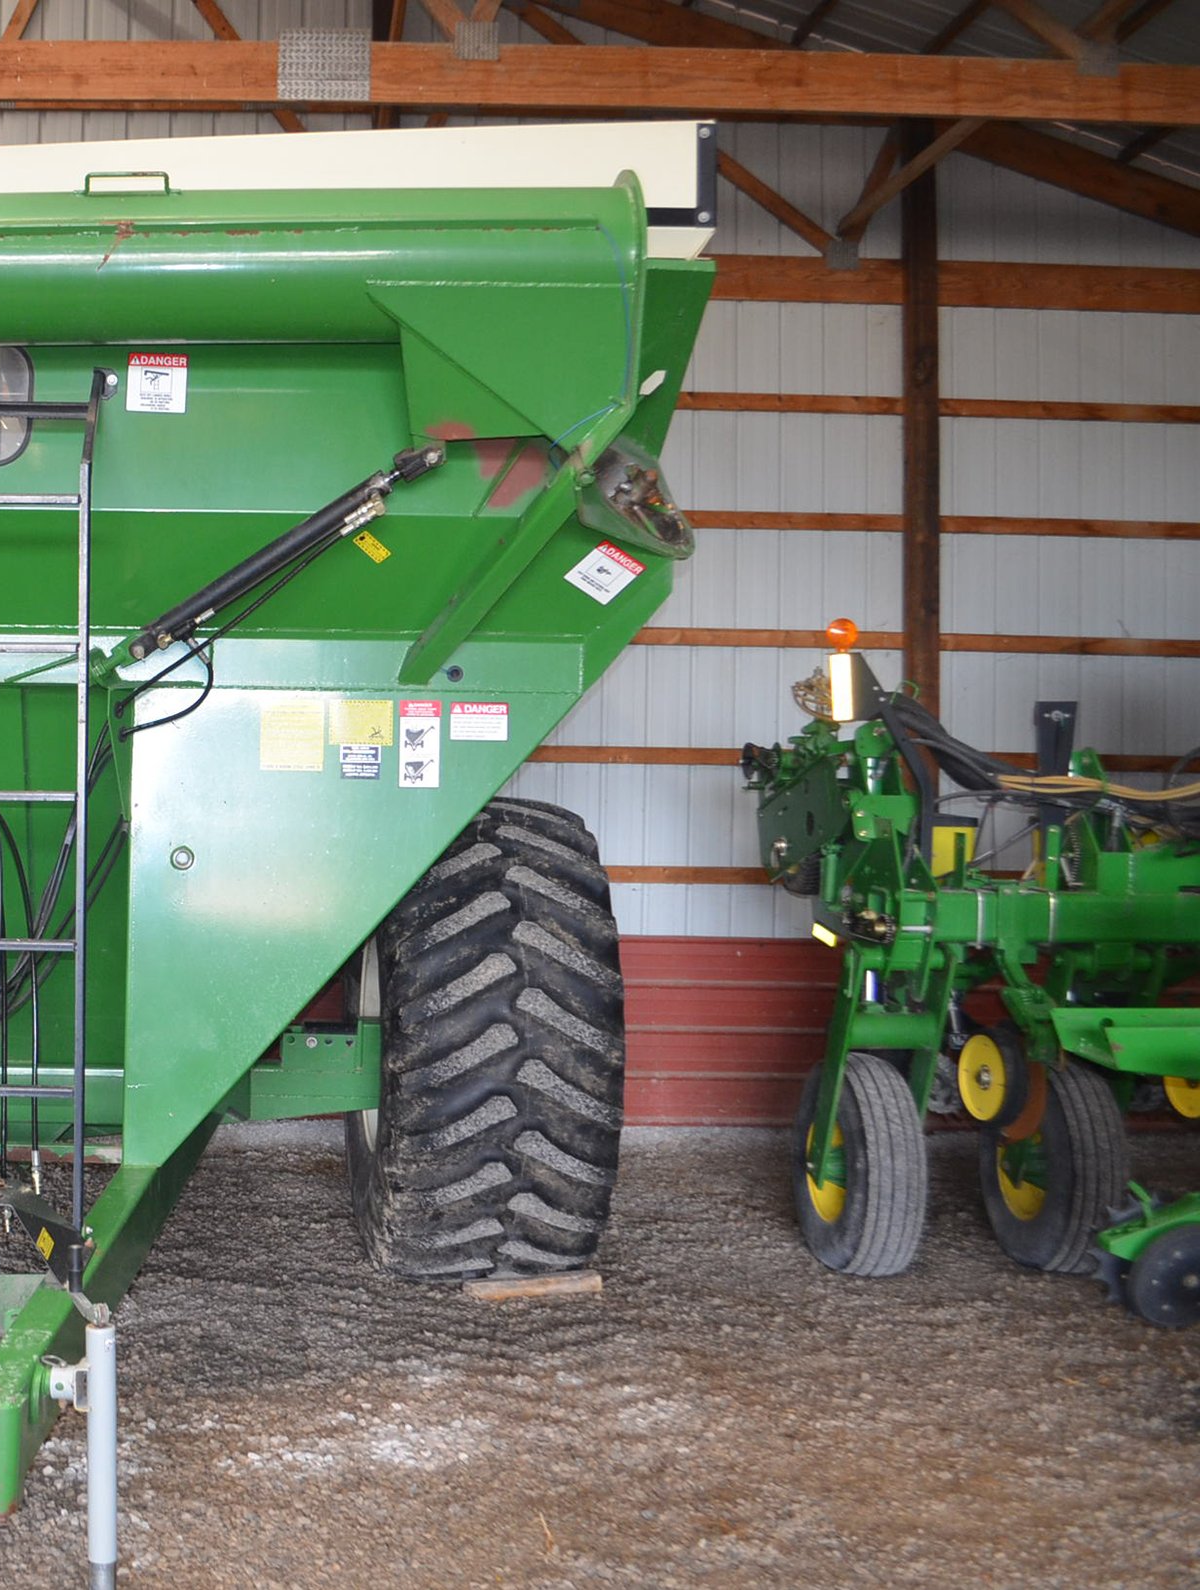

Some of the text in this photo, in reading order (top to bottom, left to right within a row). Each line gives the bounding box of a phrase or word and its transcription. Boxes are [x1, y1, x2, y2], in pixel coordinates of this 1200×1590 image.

[140, 355, 187, 367] DANGER
[606, 547, 644, 574] DANGER
[463, 704, 507, 714] DANGER
